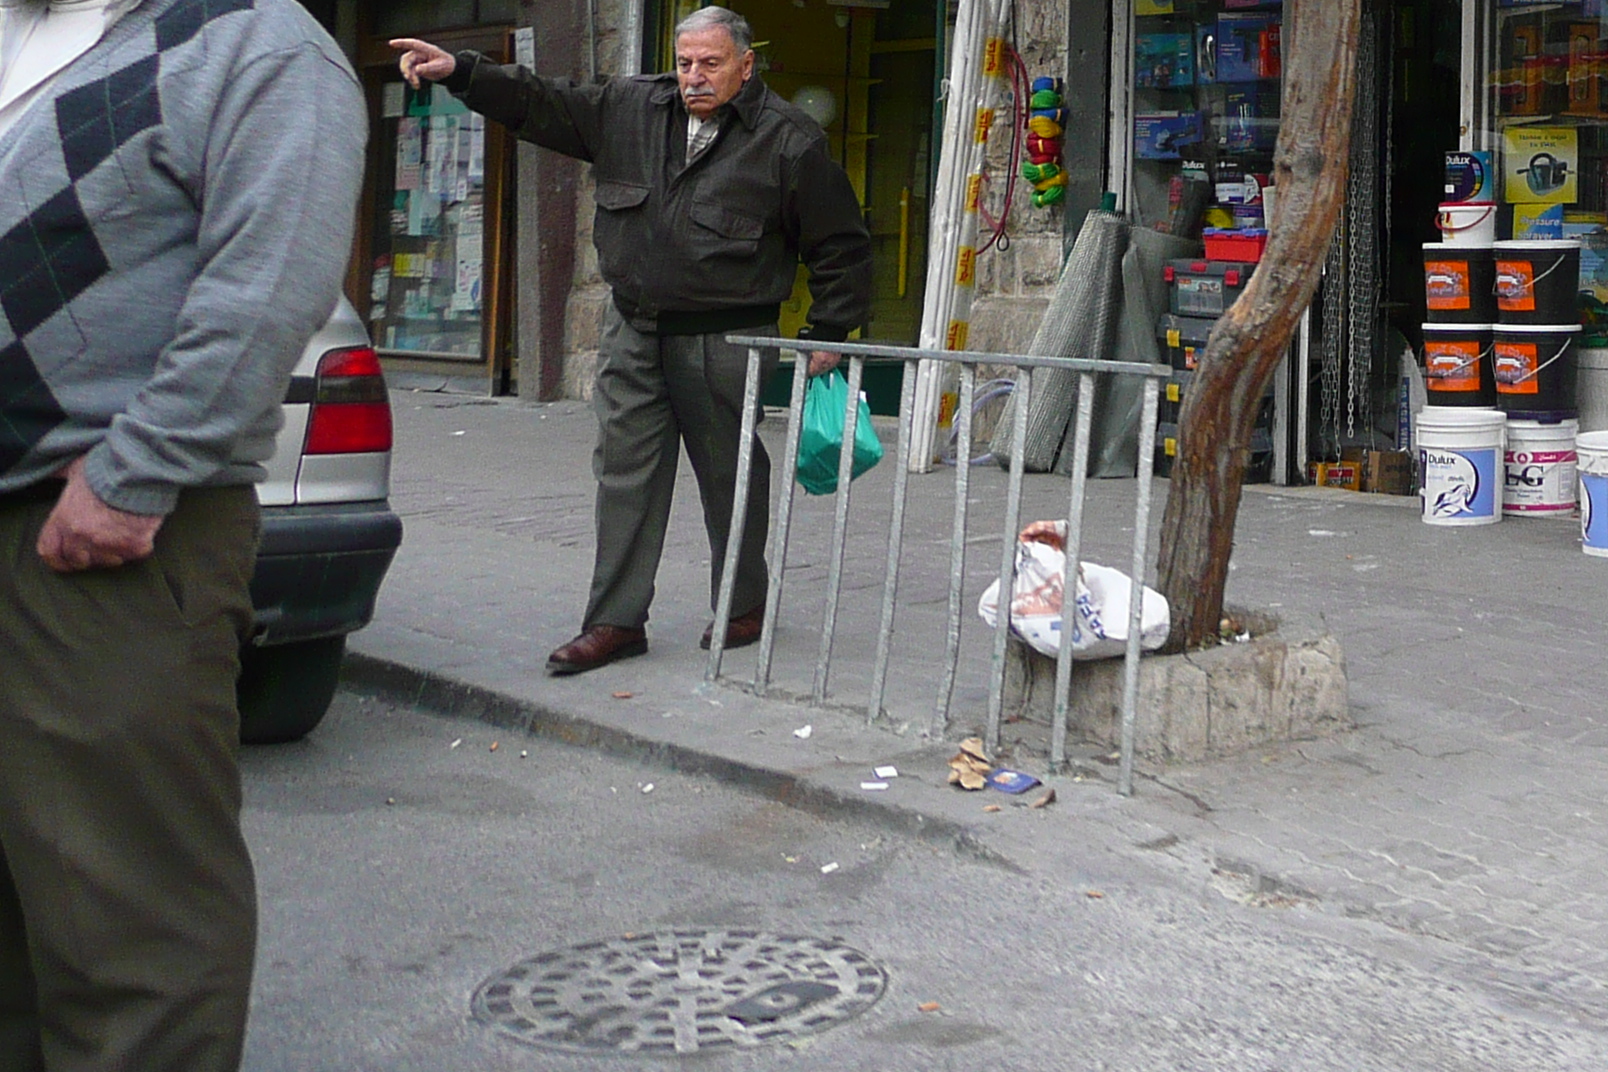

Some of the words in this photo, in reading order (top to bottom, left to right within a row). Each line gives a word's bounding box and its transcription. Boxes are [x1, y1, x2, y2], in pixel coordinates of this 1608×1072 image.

[1445, 155, 1471, 166] Dulux
[1519, 215, 1560, 227] Pressure
[1428, 453, 1456, 466] Dulux
